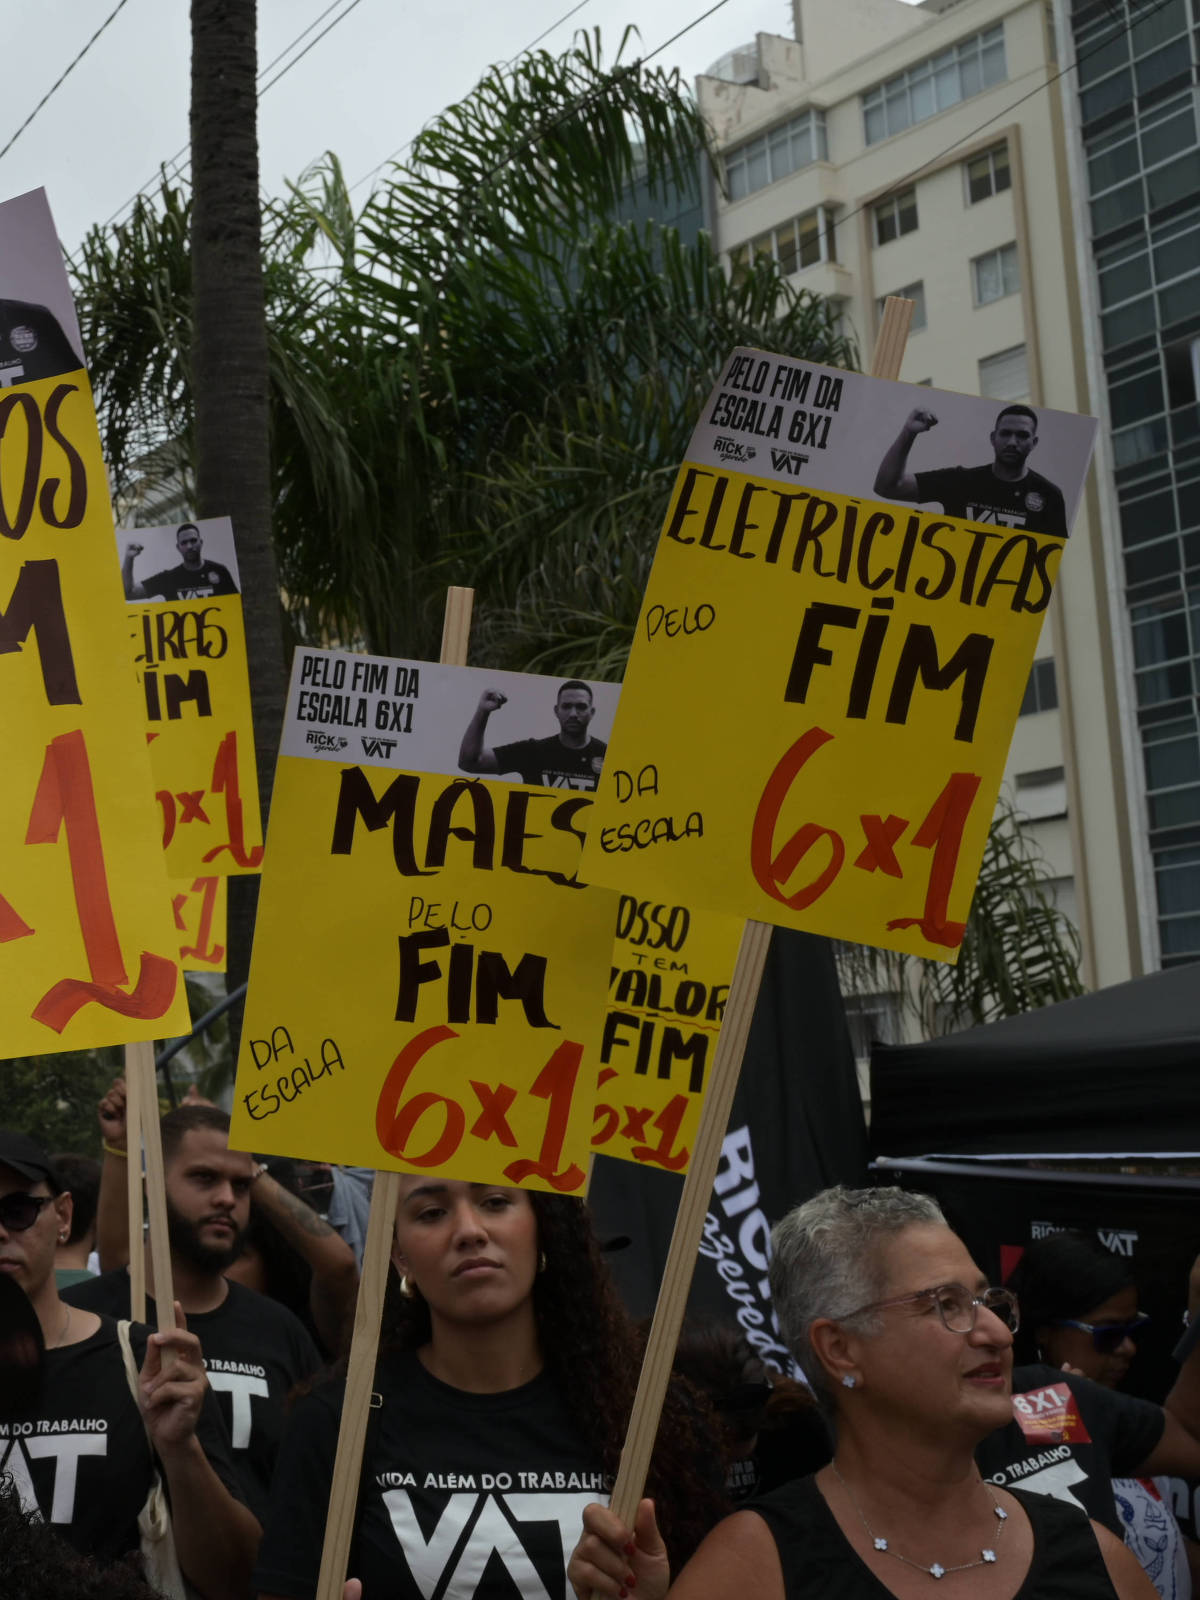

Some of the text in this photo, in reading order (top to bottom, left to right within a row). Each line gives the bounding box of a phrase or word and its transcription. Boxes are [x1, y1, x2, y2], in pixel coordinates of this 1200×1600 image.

[723, 355, 845, 413] PELO FIM DA
[709, 392, 832, 450] ESCALA 6X1
[713, 439, 744, 456] RICK
[770, 450, 809, 475] VAT
[666, 468, 1065, 614] ELETRICISTAS
[646, 603, 716, 642] PELO
[301, 656, 420, 699] PELO FIM DA
[784, 597, 995, 743] FIM
[136, 664, 213, 721] IM
[296, 691, 414, 734] ESCALA 6X1
[306, 733, 336, 746] RICK
[361, 738, 398, 759] VAT
[613, 764, 659, 803] DA
[600, 811, 704, 854] ESCALA
[408, 895, 493, 932] PELO
[616, 894, 690, 952] OSSO
[394, 927, 561, 1030] FIM
[632, 953, 688, 975] TEM
[249, 1025, 295, 1071] DA
[601, 1011, 709, 1093] FIM
[243, 1037, 345, 1121] ESCALA
[1098, 1231, 1139, 1256] VAT
[211, 1359, 266, 1377] TRABALHO
[12, 1422, 33, 1436] DO
[36, 1419, 108, 1433] TRABALHO
[376, 1472, 417, 1487] VIDA
[423, 1472, 476, 1489] ALÉM
[482, 1472, 512, 1490] DO
[1006, 1445, 1071, 1478] TRABALHO
